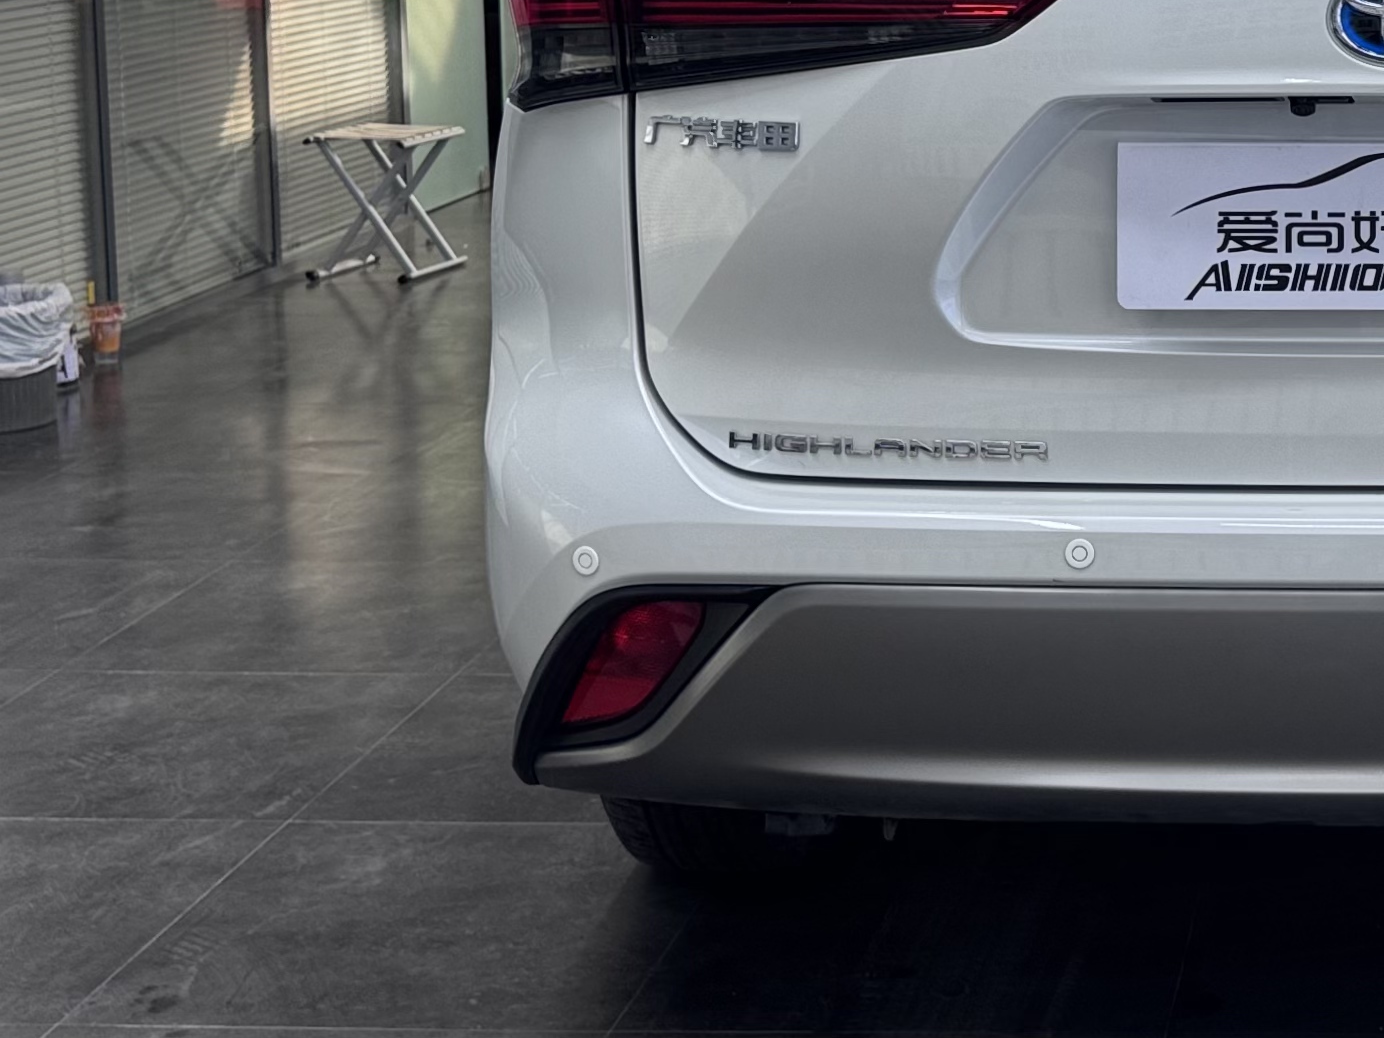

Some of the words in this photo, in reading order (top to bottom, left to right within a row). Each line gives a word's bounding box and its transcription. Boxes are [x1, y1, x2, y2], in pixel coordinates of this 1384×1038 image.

[643, 115, 800, 151] 广汽丰田
[729, 431, 1049, 460] HIGHLANDER
